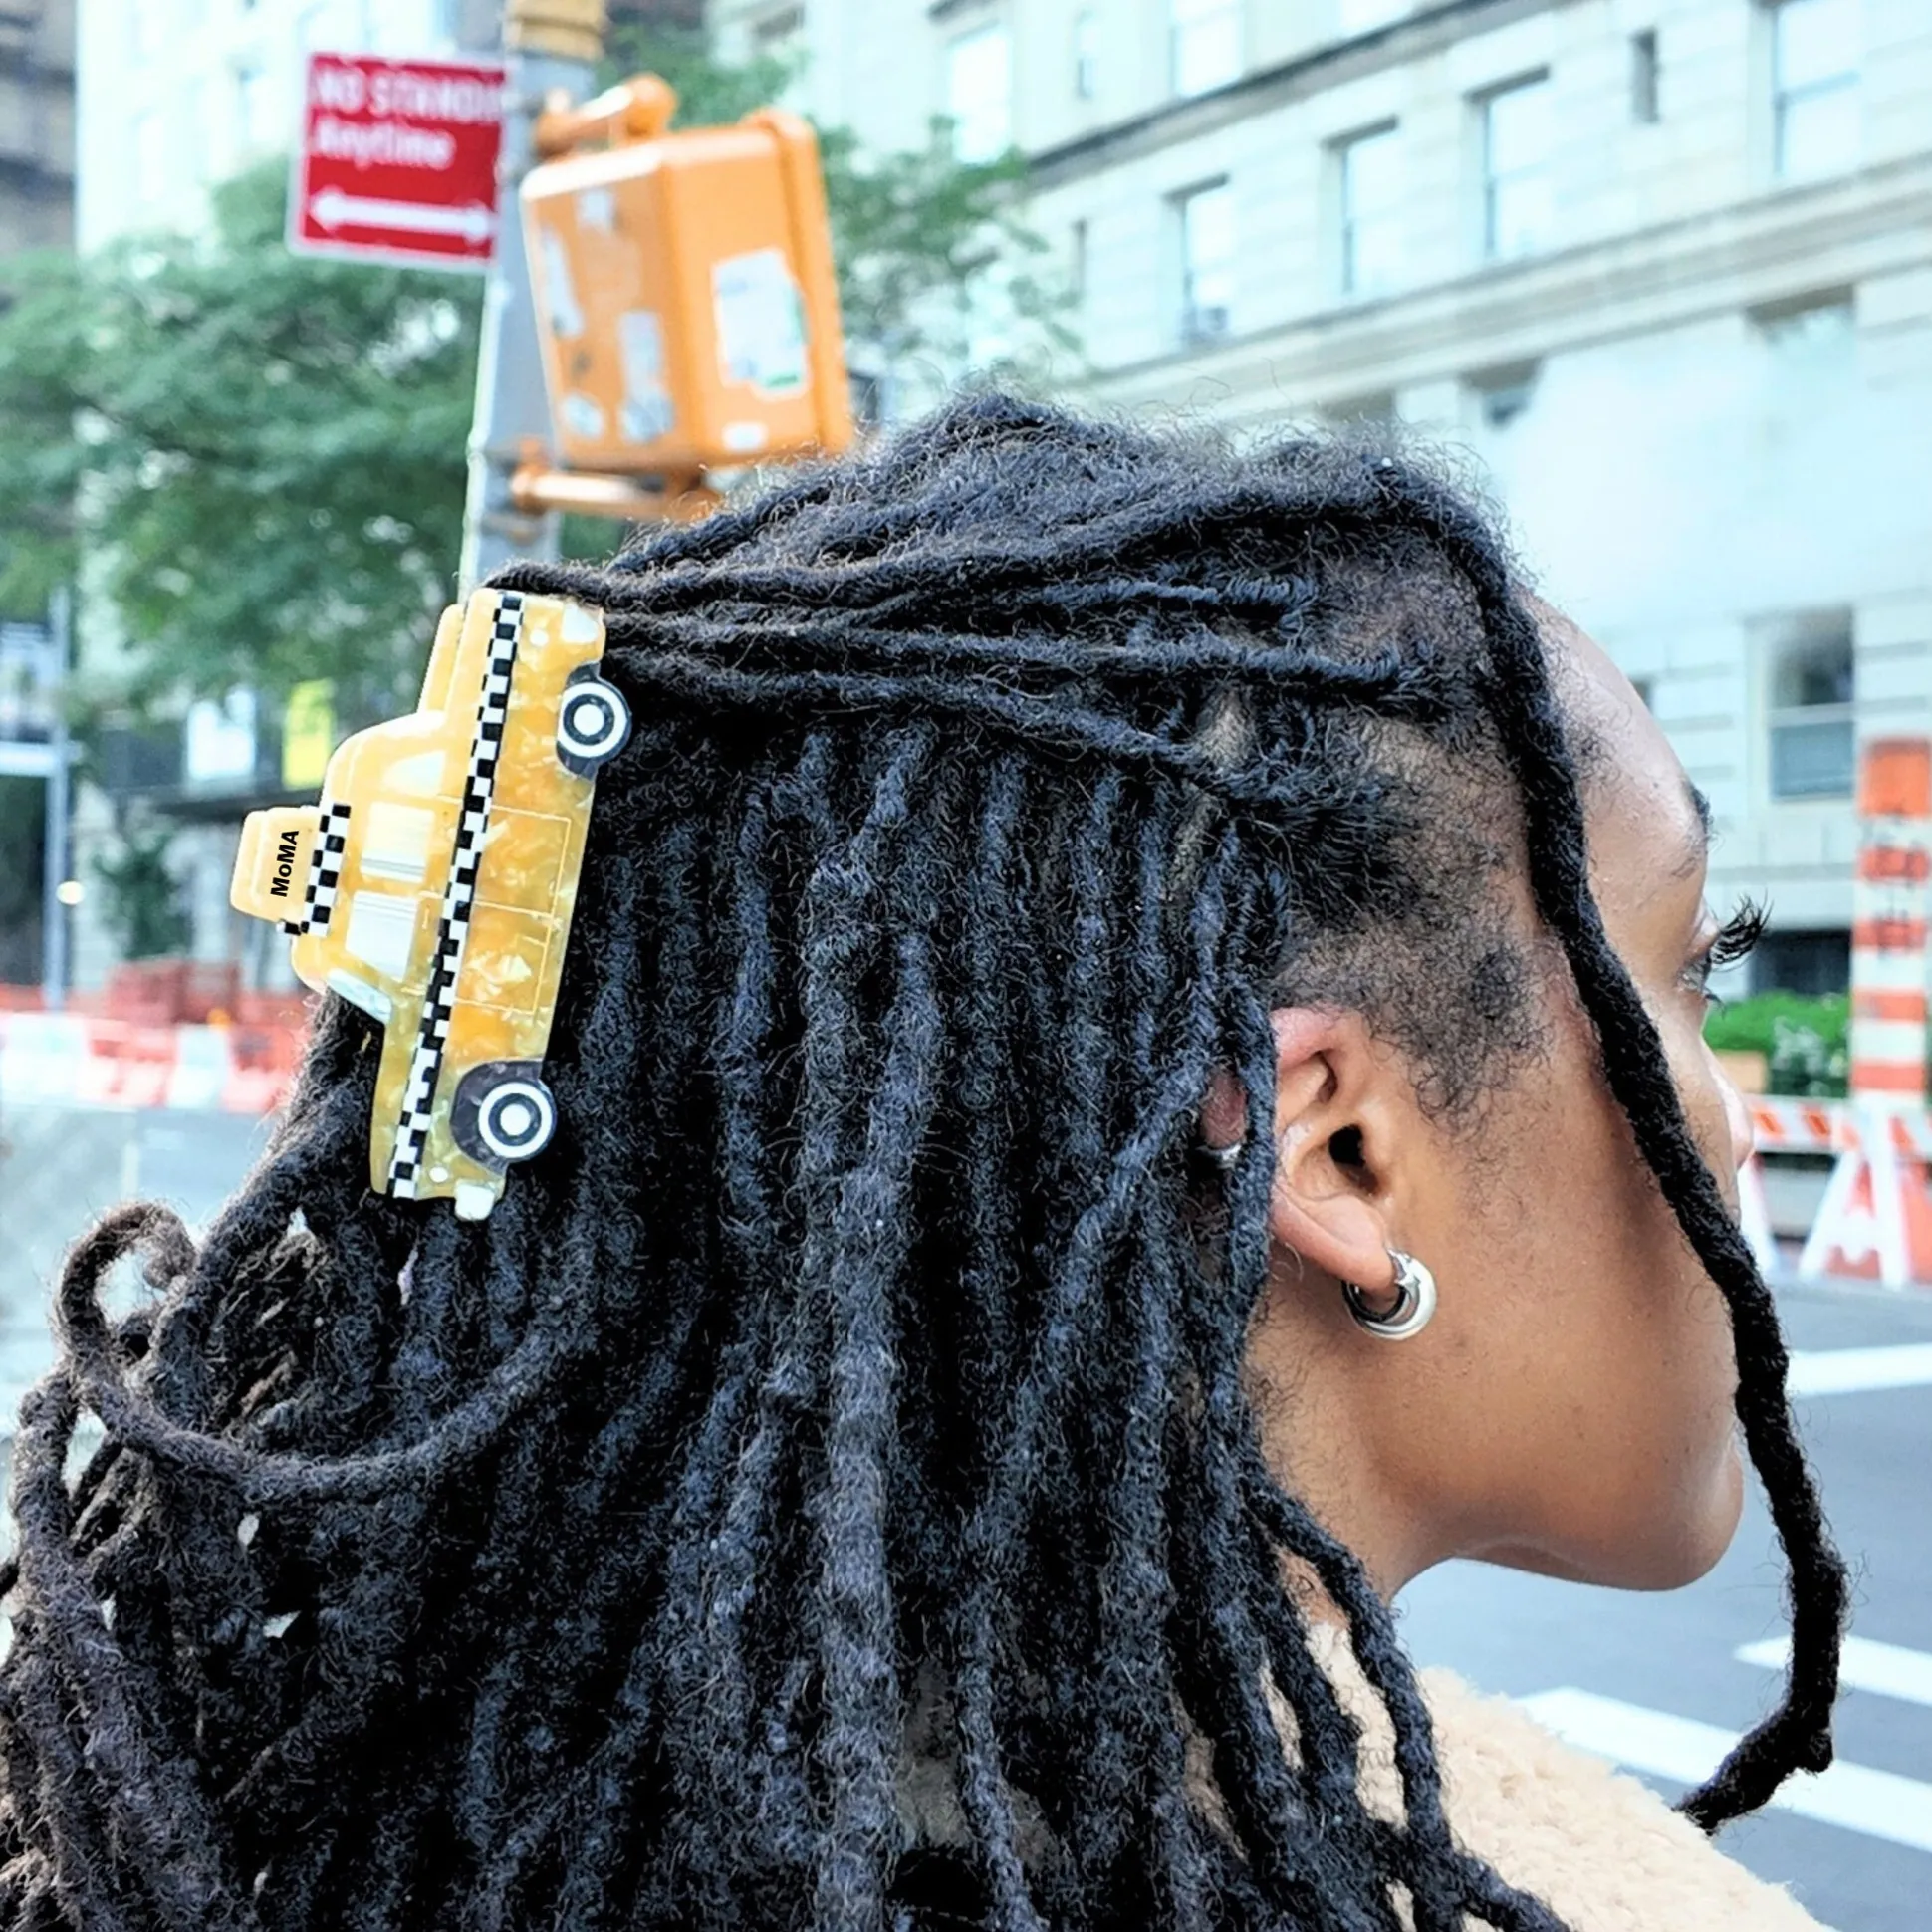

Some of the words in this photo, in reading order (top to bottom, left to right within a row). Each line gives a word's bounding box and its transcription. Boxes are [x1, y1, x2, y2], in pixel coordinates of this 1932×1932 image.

[317, 68, 366, 114] NO
[316, 118, 455, 167] Anytime
[270, 830, 300, 897] MoMA
